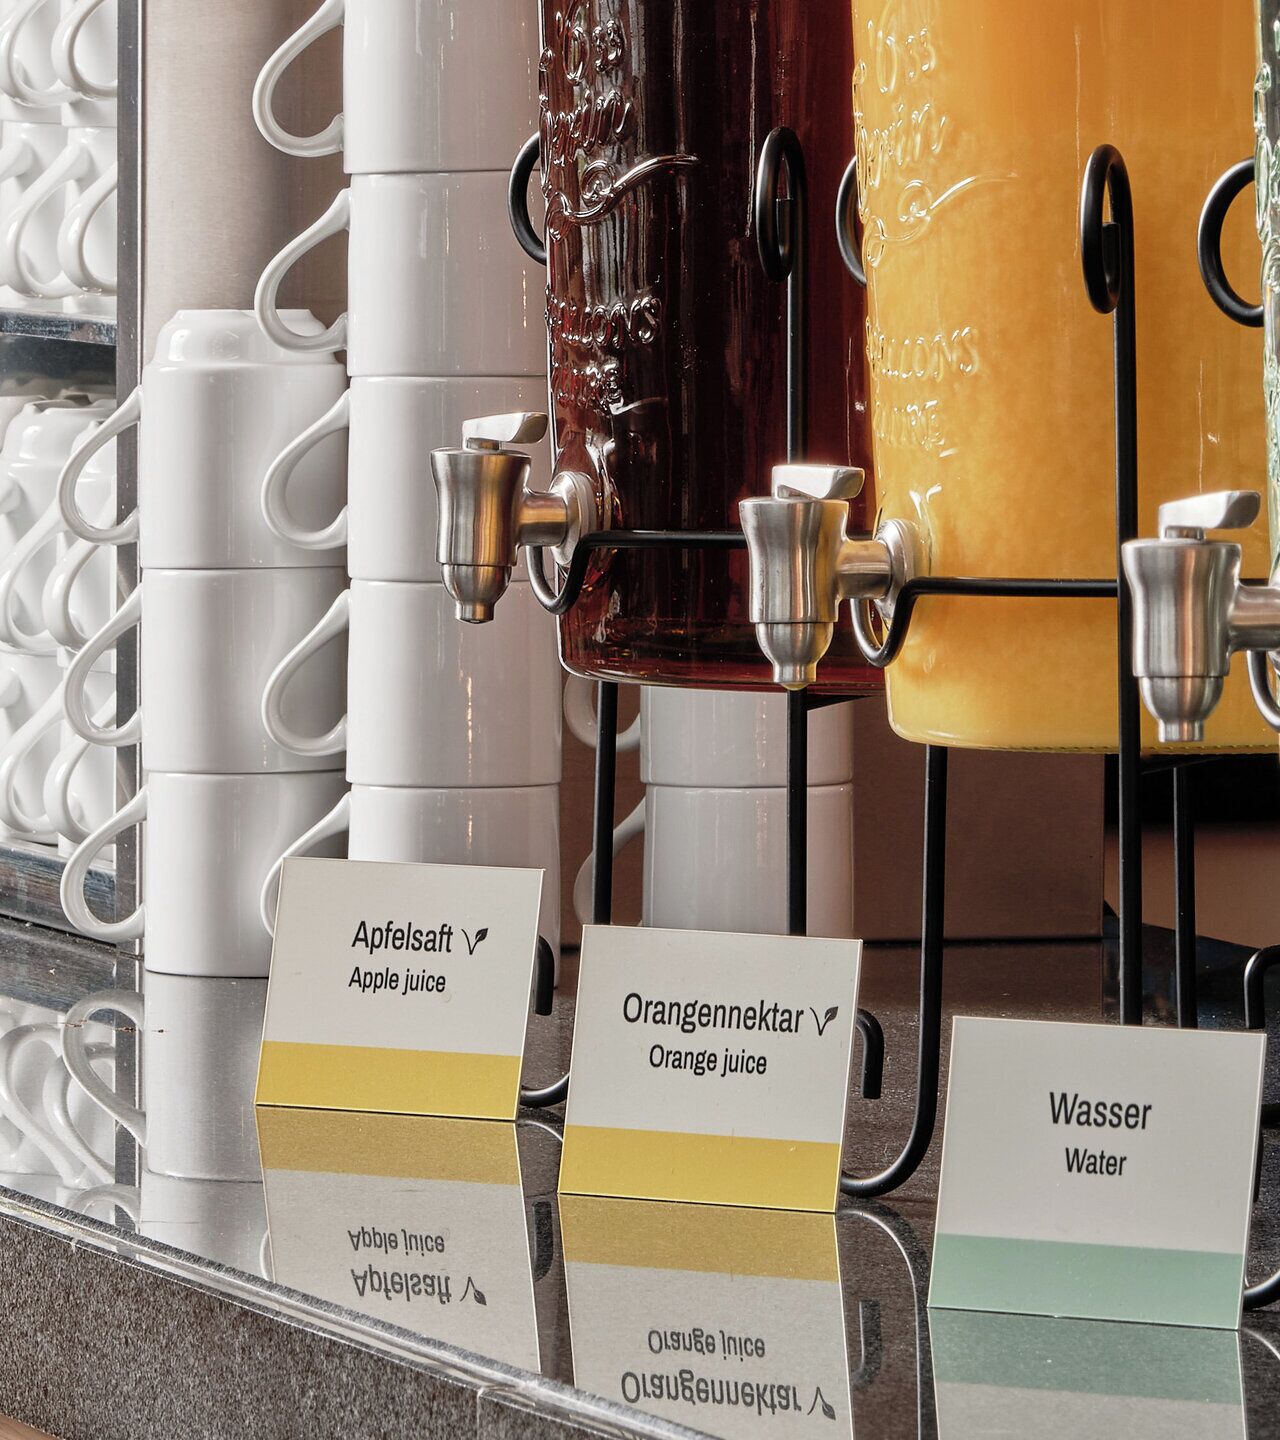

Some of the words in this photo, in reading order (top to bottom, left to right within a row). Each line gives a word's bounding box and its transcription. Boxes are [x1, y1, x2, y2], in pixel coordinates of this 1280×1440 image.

[351, 920, 454, 955] Apfelsaft
[348, 966, 400, 994] Apple
[401, 973, 446, 996] juice
[623, 992, 805, 1034] Orangennektar
[649, 1044, 718, 1076] Orange
[720, 1047, 767, 1078] juice
[1049, 1091, 1153, 1130] Wasser
[1065, 1147, 1127, 1176] Water
